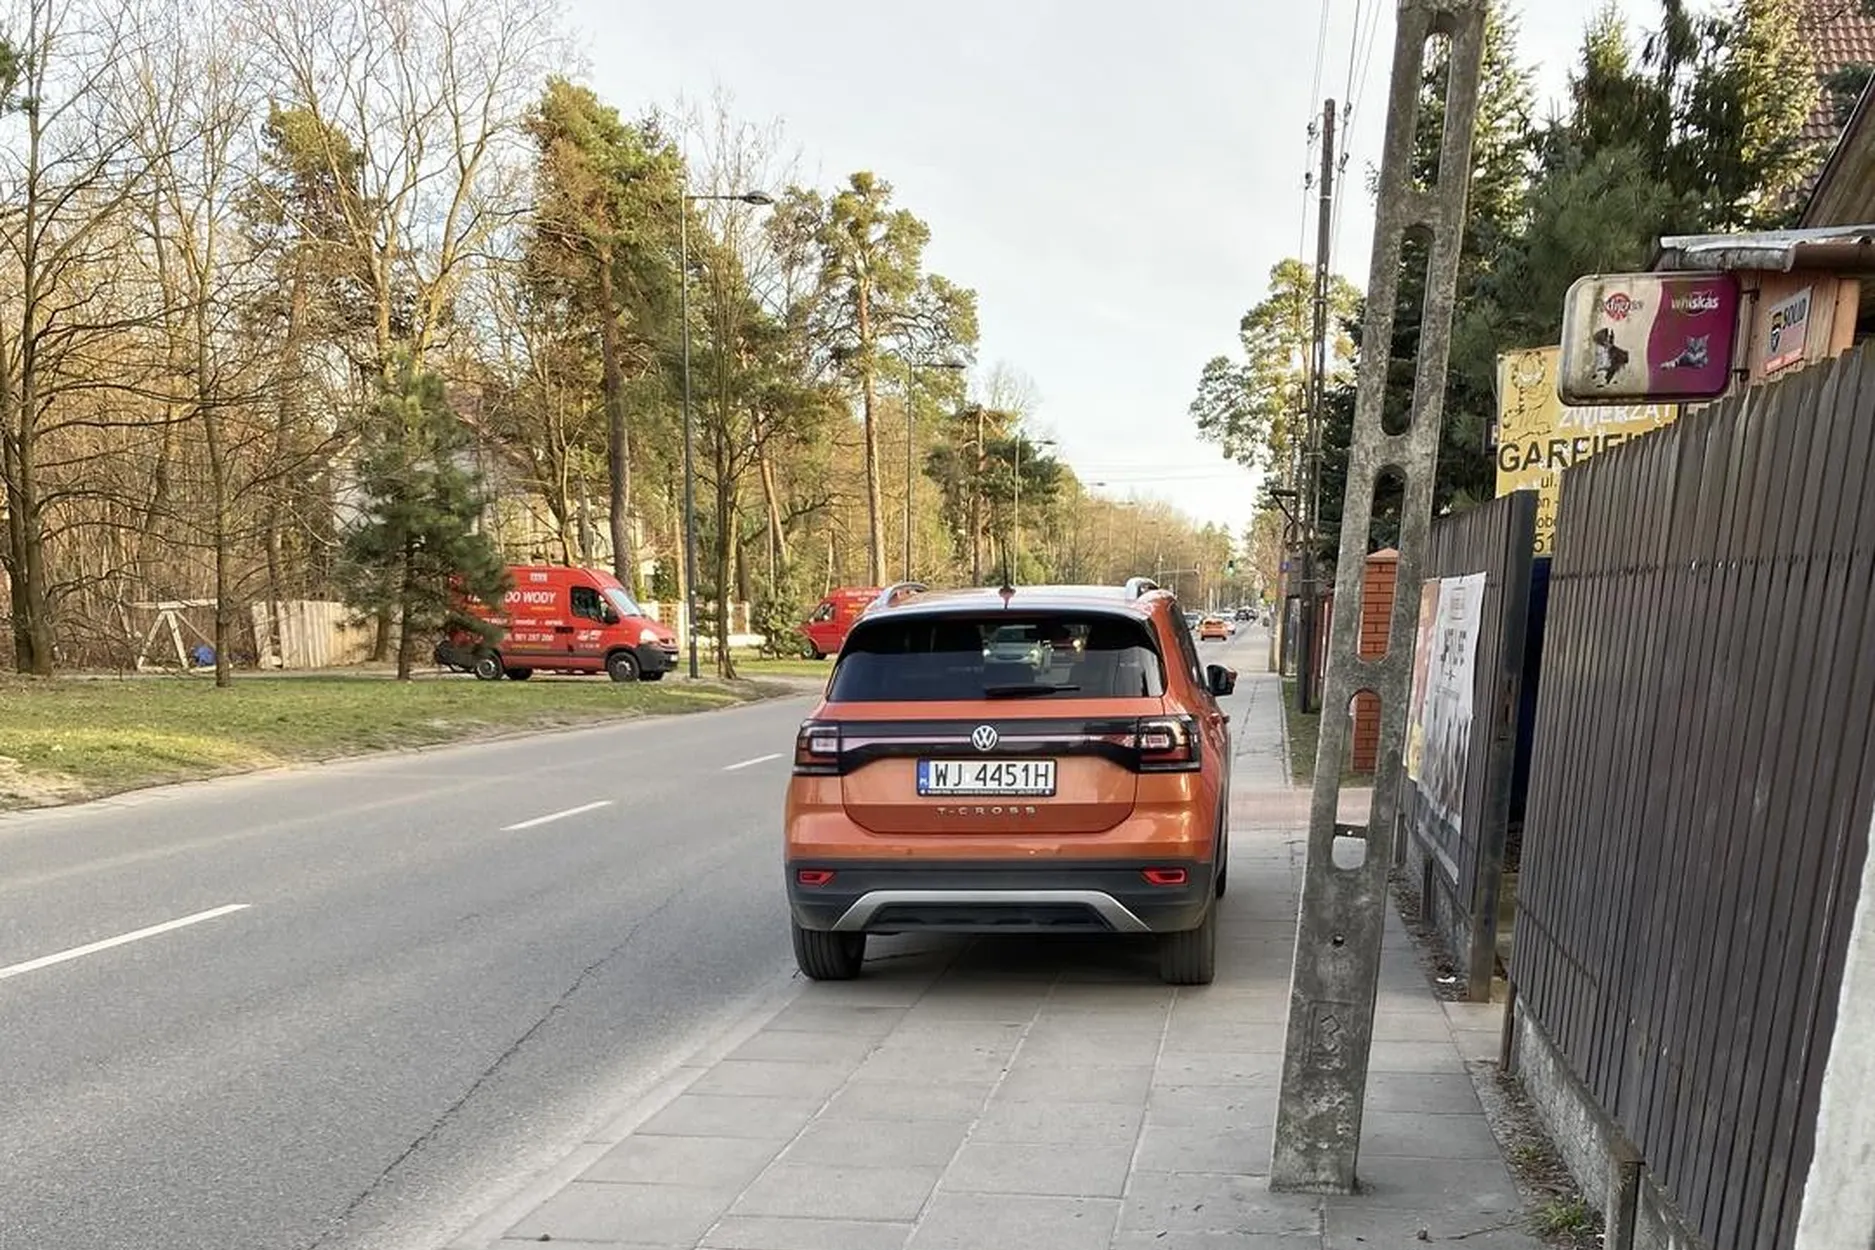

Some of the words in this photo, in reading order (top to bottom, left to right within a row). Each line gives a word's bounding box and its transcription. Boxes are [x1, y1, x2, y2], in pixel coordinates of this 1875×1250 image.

[1671, 294, 1718, 309] whiskas
[523, 591, 556, 604] WODY
[934, 764, 962, 787] WJ
[974, 764, 1049, 787] 4451H
[937, 806, 1035, 816] T-CROSS
